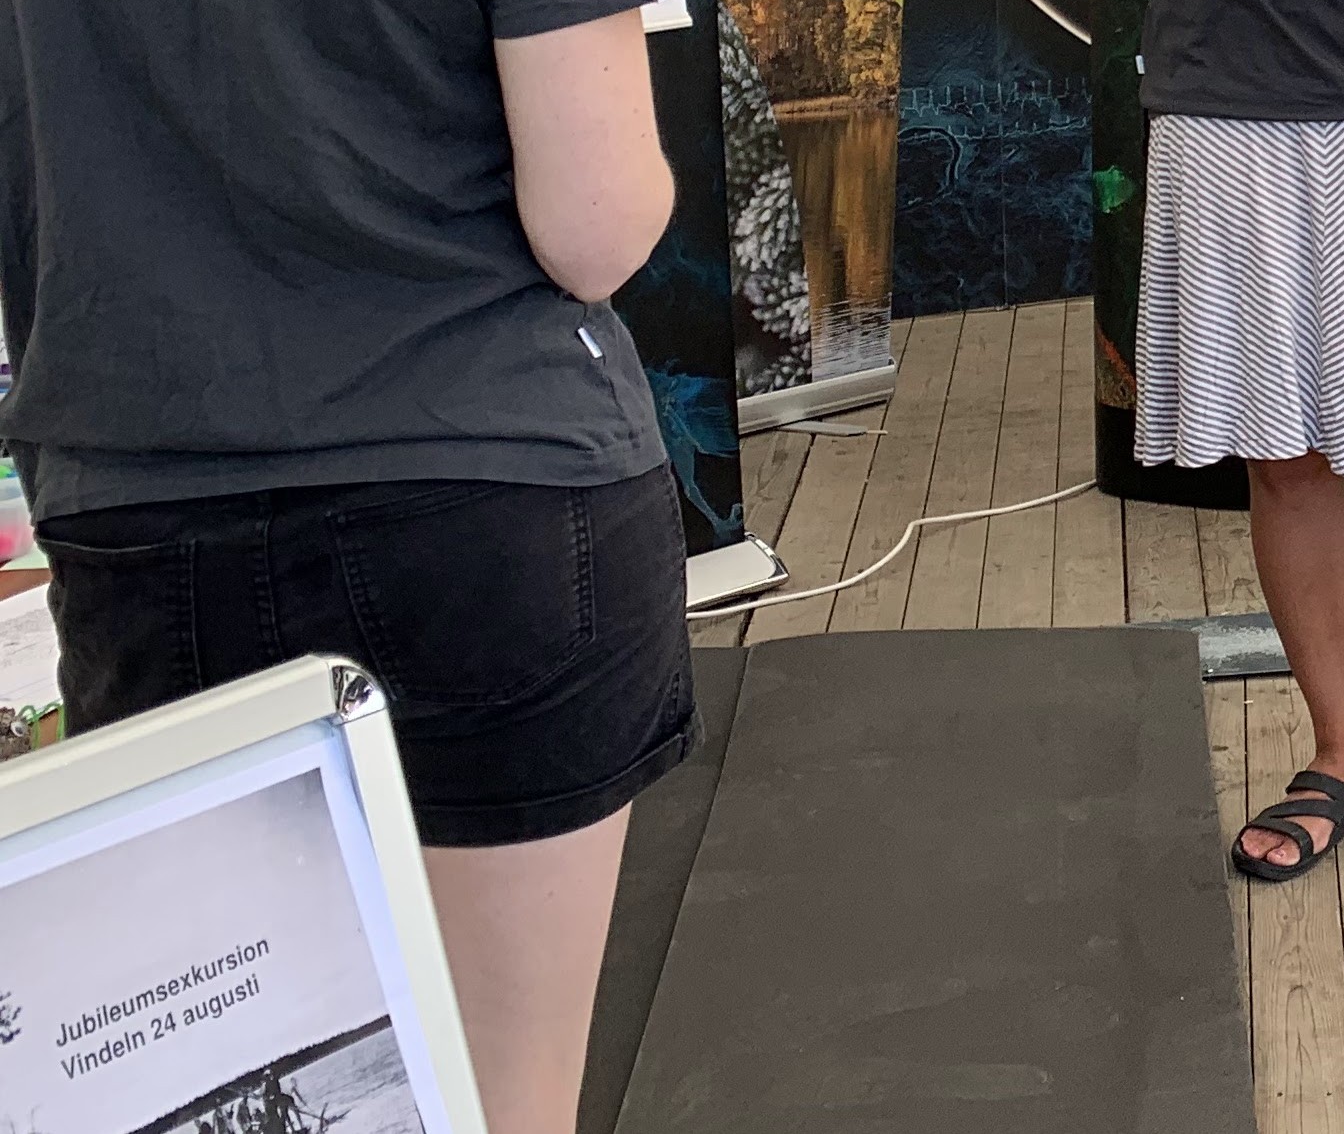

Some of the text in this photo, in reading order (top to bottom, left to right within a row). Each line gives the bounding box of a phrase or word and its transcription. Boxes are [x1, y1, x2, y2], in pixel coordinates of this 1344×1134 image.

[56, 938, 270, 1047] Jubileumsexkursion
[60, 973, 261, 1080] Vindeln 24 augusti
